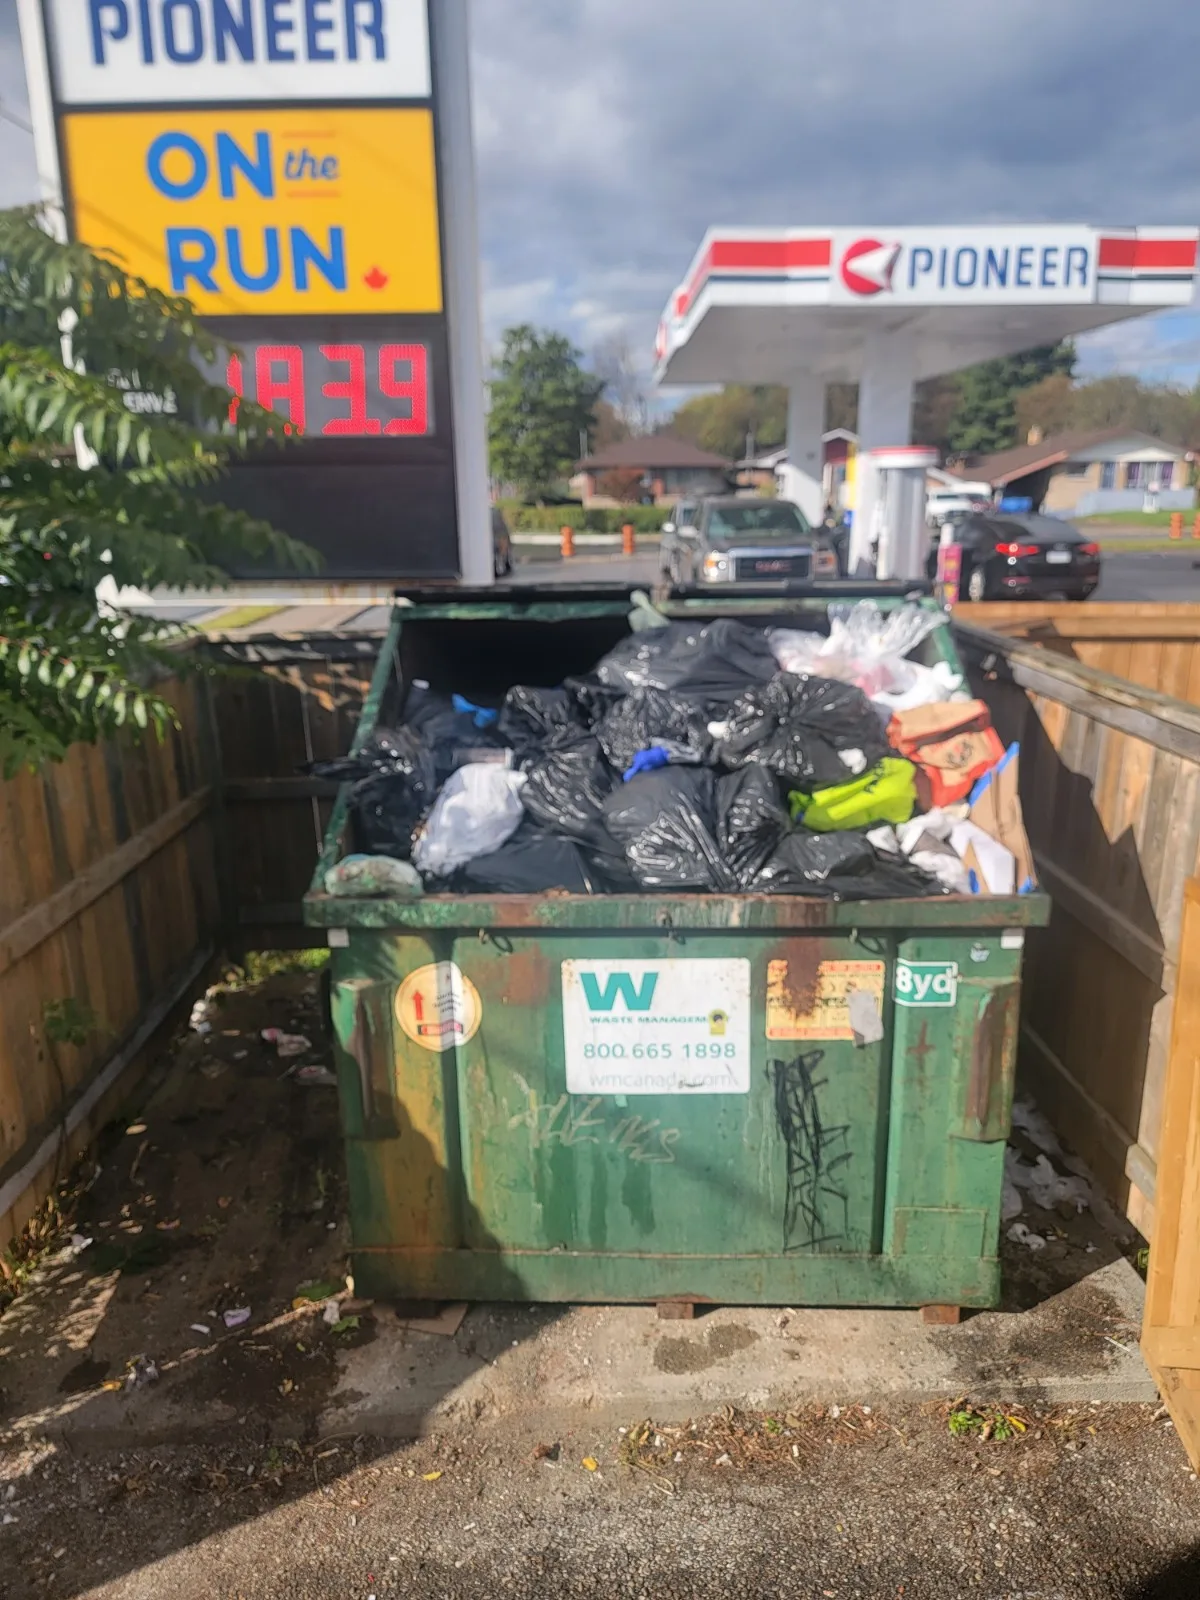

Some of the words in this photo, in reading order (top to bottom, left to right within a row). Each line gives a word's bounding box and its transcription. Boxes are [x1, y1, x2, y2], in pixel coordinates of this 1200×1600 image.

[88, 0, 387, 66] PIONEER
[146, 131, 275, 201] ON
[284, 149, 339, 180] the
[165, 226, 348, 293] RUN
[908, 246, 1089, 289] PIONEER
[896, 966, 952, 1000] 8yd
[589, 1016, 633, 1024] WASTE
[638, 1015, 729, 1024] MANAGEM
[682, 1042, 736, 1059] 1898
